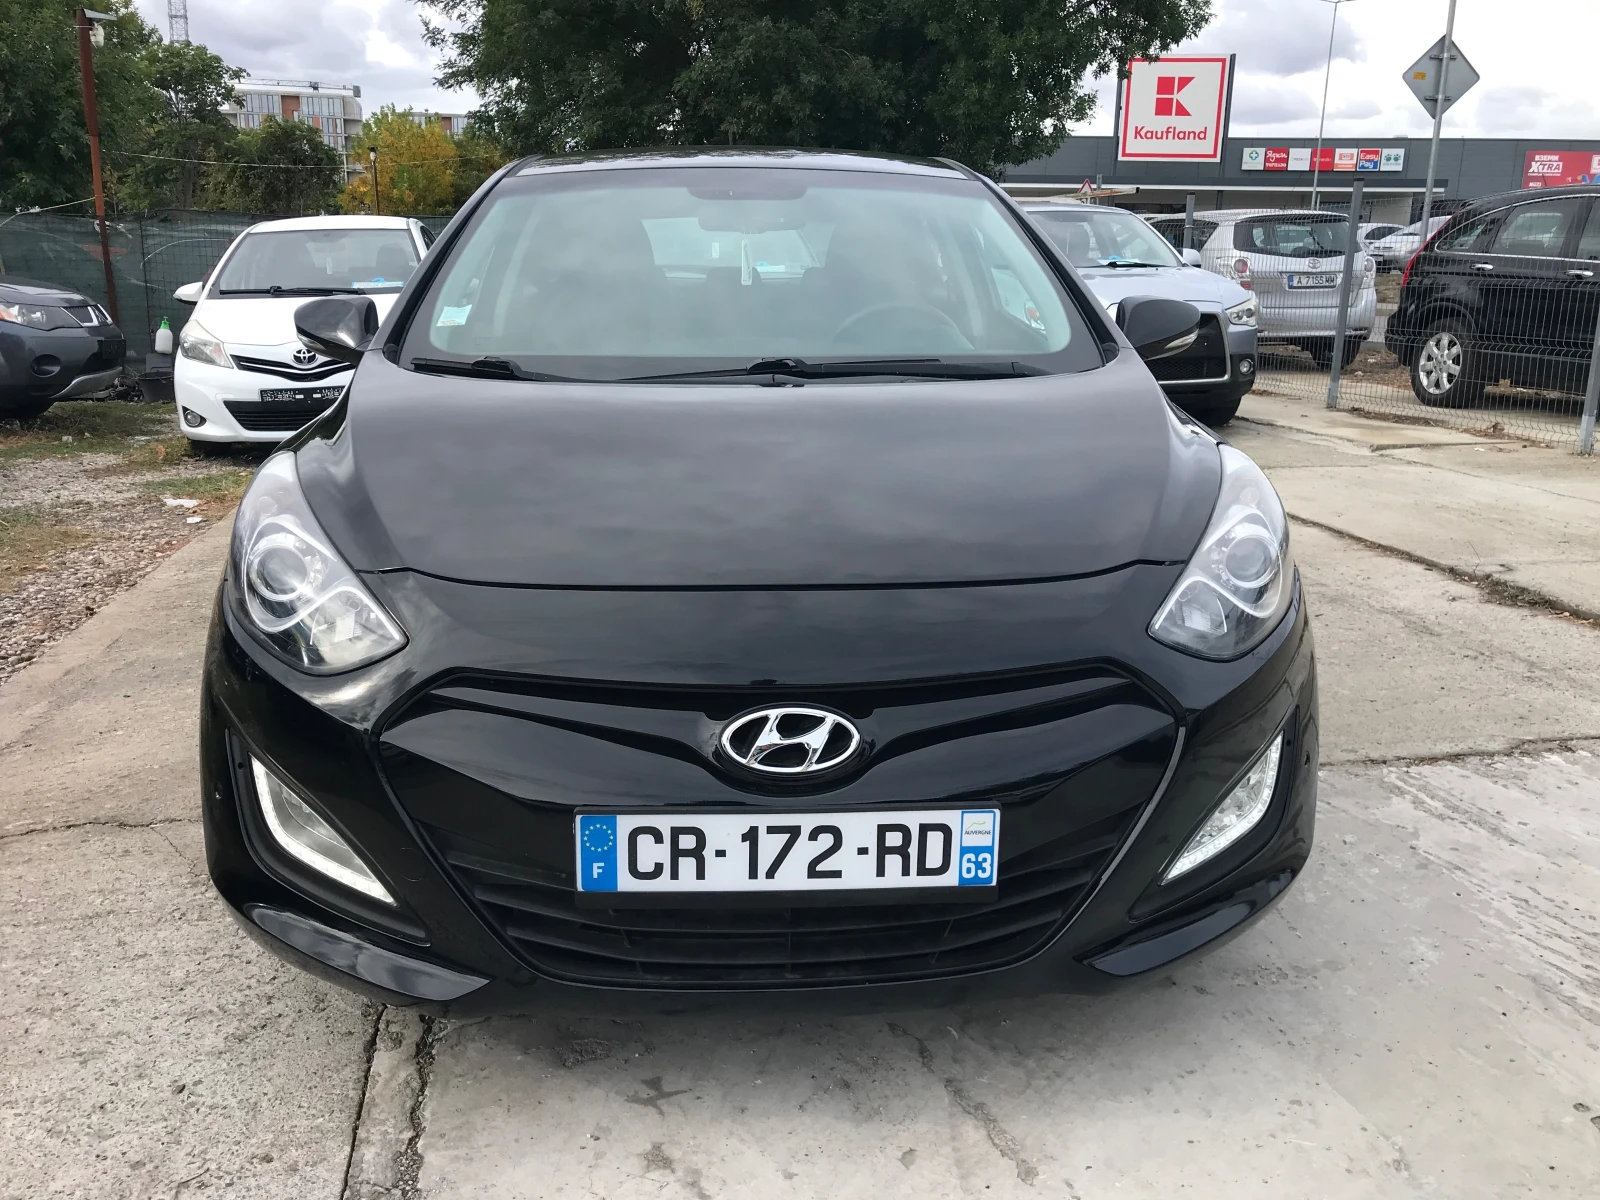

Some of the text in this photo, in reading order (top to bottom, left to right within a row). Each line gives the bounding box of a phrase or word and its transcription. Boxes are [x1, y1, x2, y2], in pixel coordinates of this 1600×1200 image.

[1133, 126, 1208, 140] Kaufland
[1360, 153, 1379, 161] Easy
[1528, 162, 1563, 173] XTRA
[627, 823, 953, 880] CR-172-RD
[592, 863, 604, 878] F
[961, 852, 992, 879] 63
